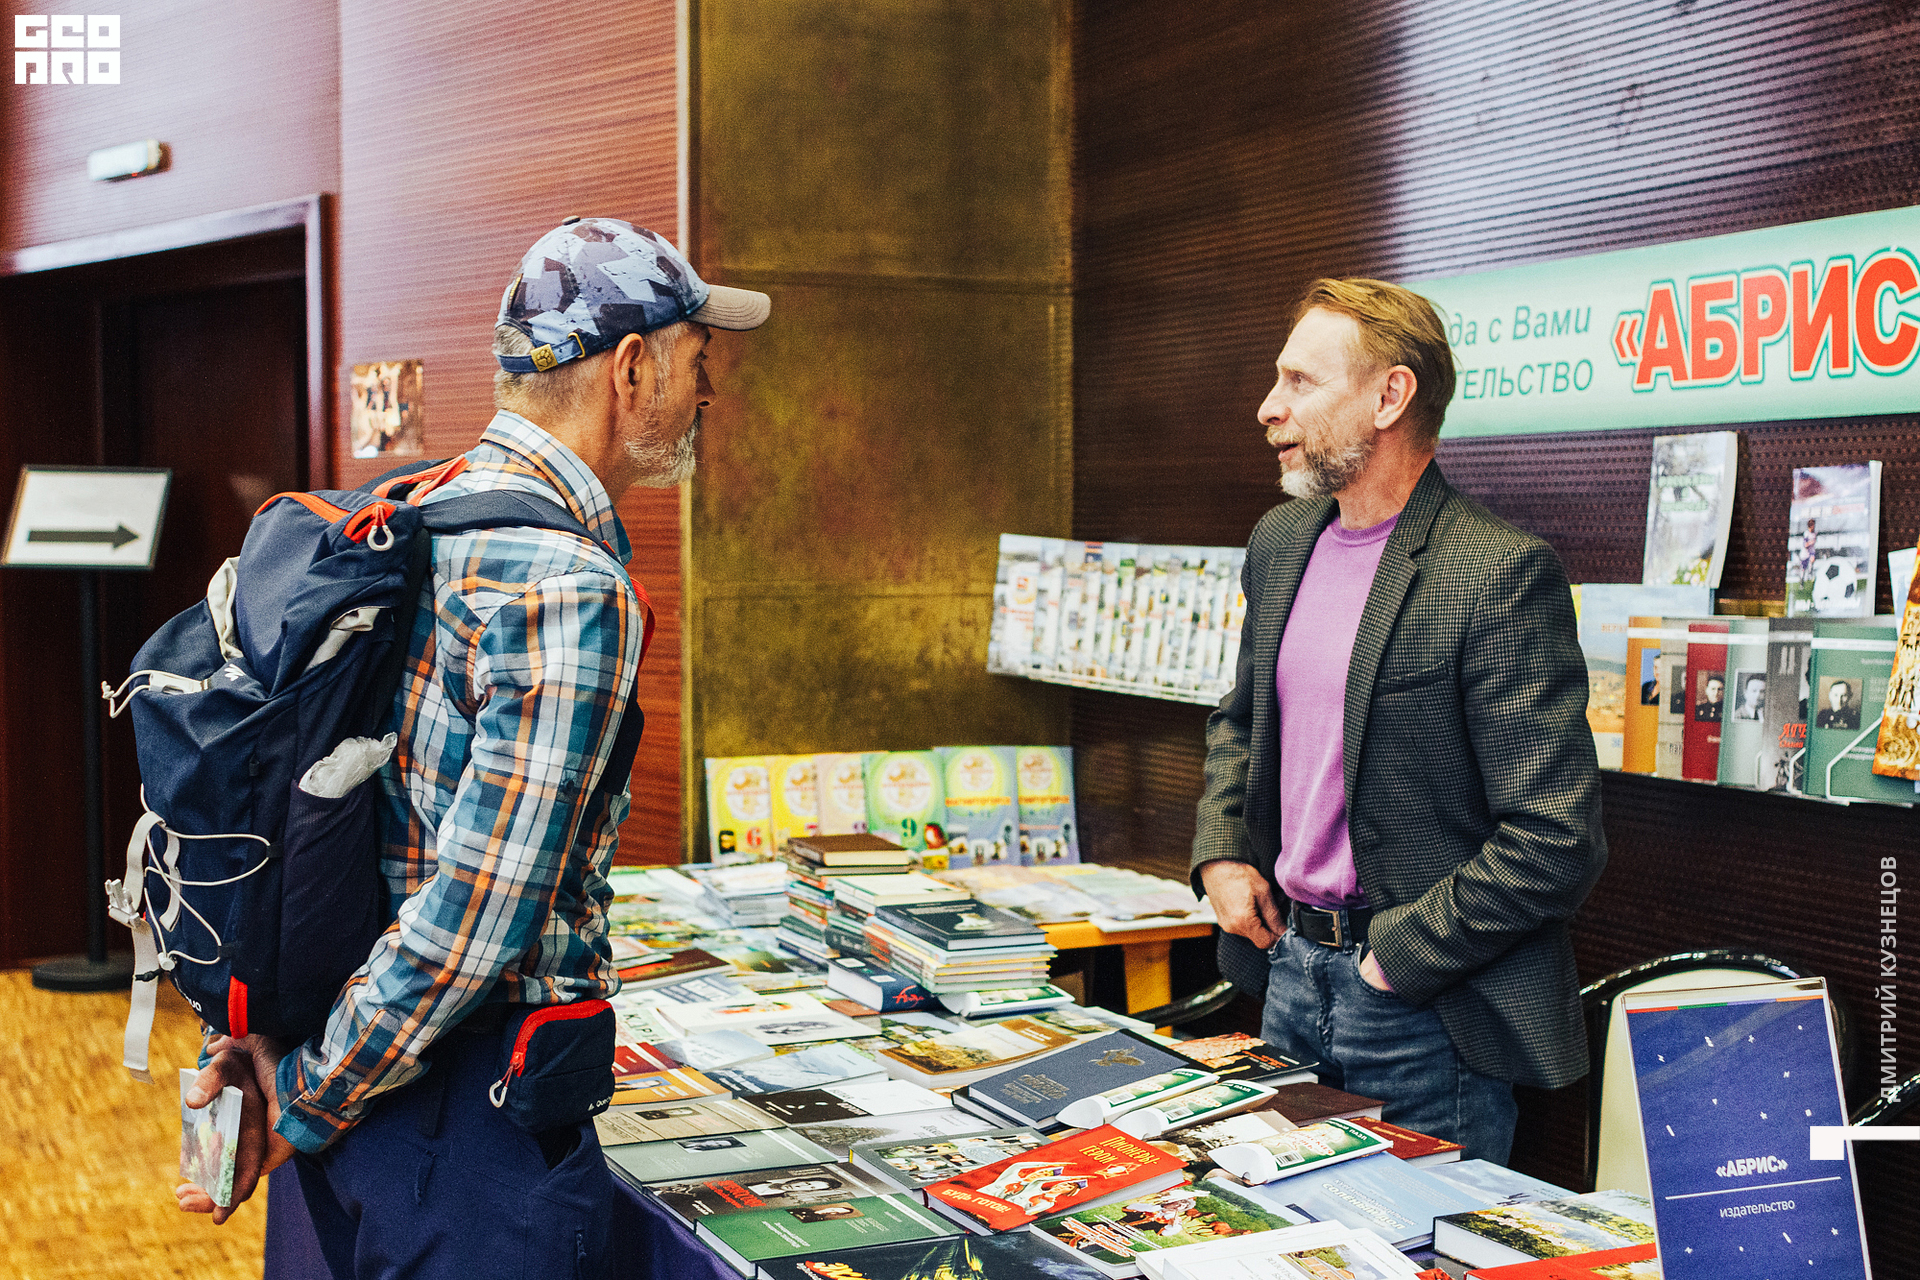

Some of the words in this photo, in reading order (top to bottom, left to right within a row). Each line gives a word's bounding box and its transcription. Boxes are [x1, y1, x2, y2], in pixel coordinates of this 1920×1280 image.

[1489, 318, 1502, 343] с
[1513, 306, 1591, 340] Вами
[1611, 247, 1920, 392] «АБРИС
[901, 818, 917, 838] 9
[1349, 1128, 1368, 1141] ПАЗЛ
[1078, 1145, 1119, 1164] ГЕРОИ
[1716, 1155, 1788, 1177] «АБРИС»
[941, 1188, 972, 1201] БУДЬ
[971, 1197, 1012, 1213] ГОТОВ!
[1719, 1200, 1796, 1218] издательство
